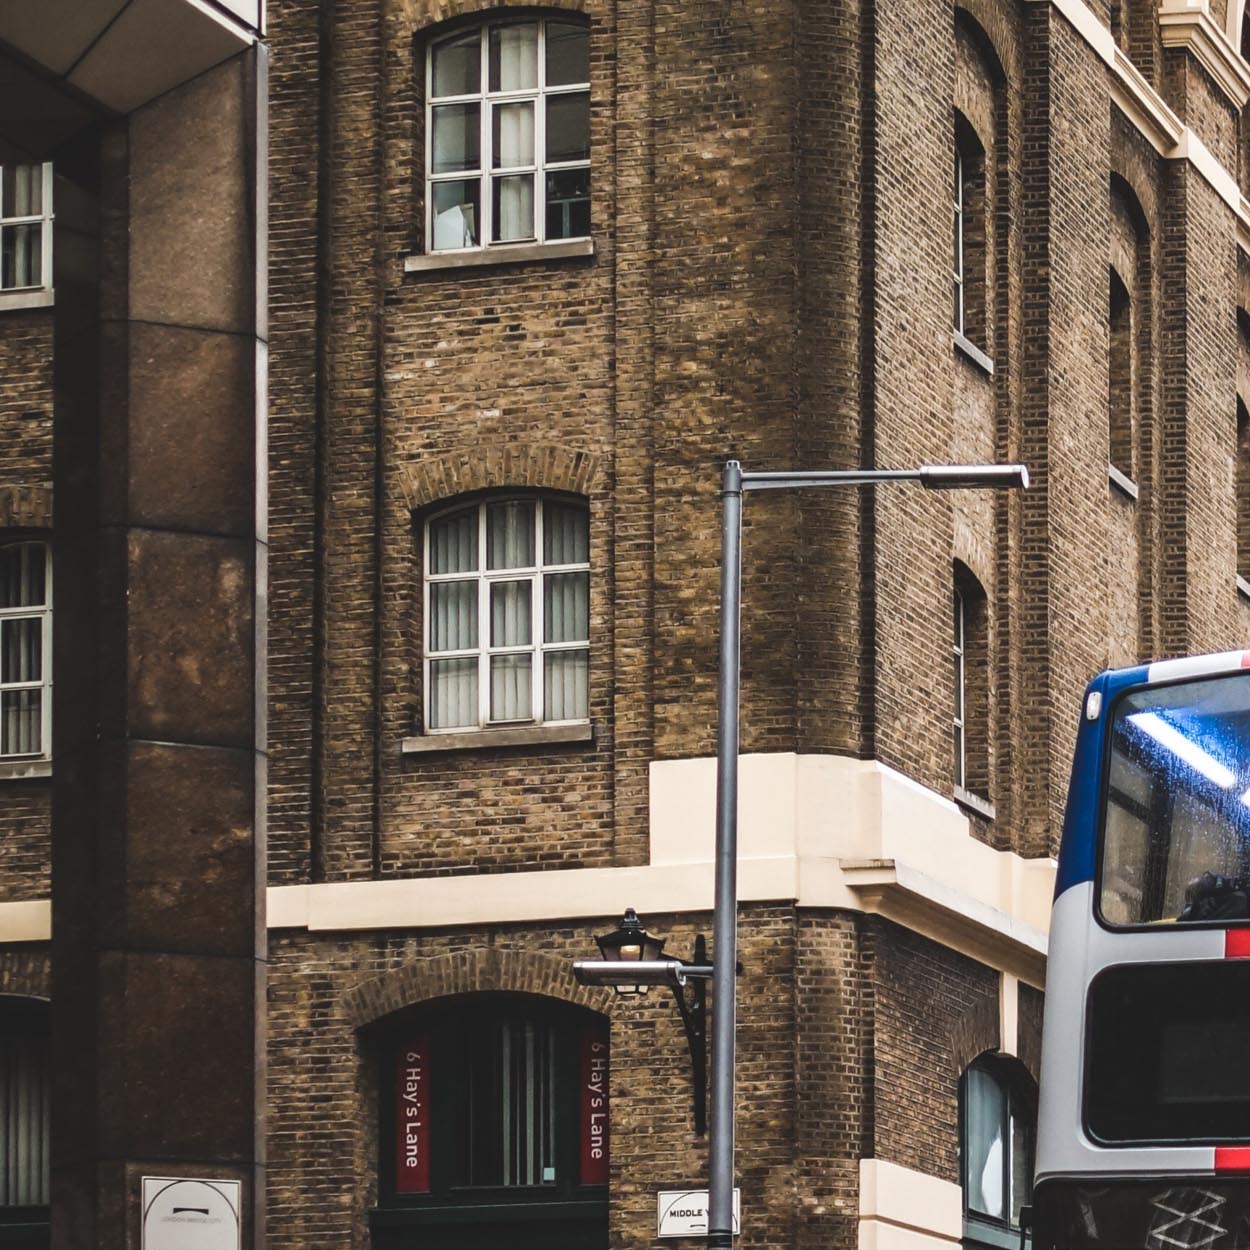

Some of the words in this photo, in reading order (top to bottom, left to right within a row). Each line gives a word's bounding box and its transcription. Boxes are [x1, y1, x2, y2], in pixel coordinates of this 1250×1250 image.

[406, 1051, 421, 1062] 6
[403, 1067, 422, 1117] Hay's
[587, 1058, 606, 1108] Hay's
[406, 1122, 422, 1168] Lane
[590, 1113, 606, 1159] Lane
[669, 1208, 703, 1218] MIDDLE
